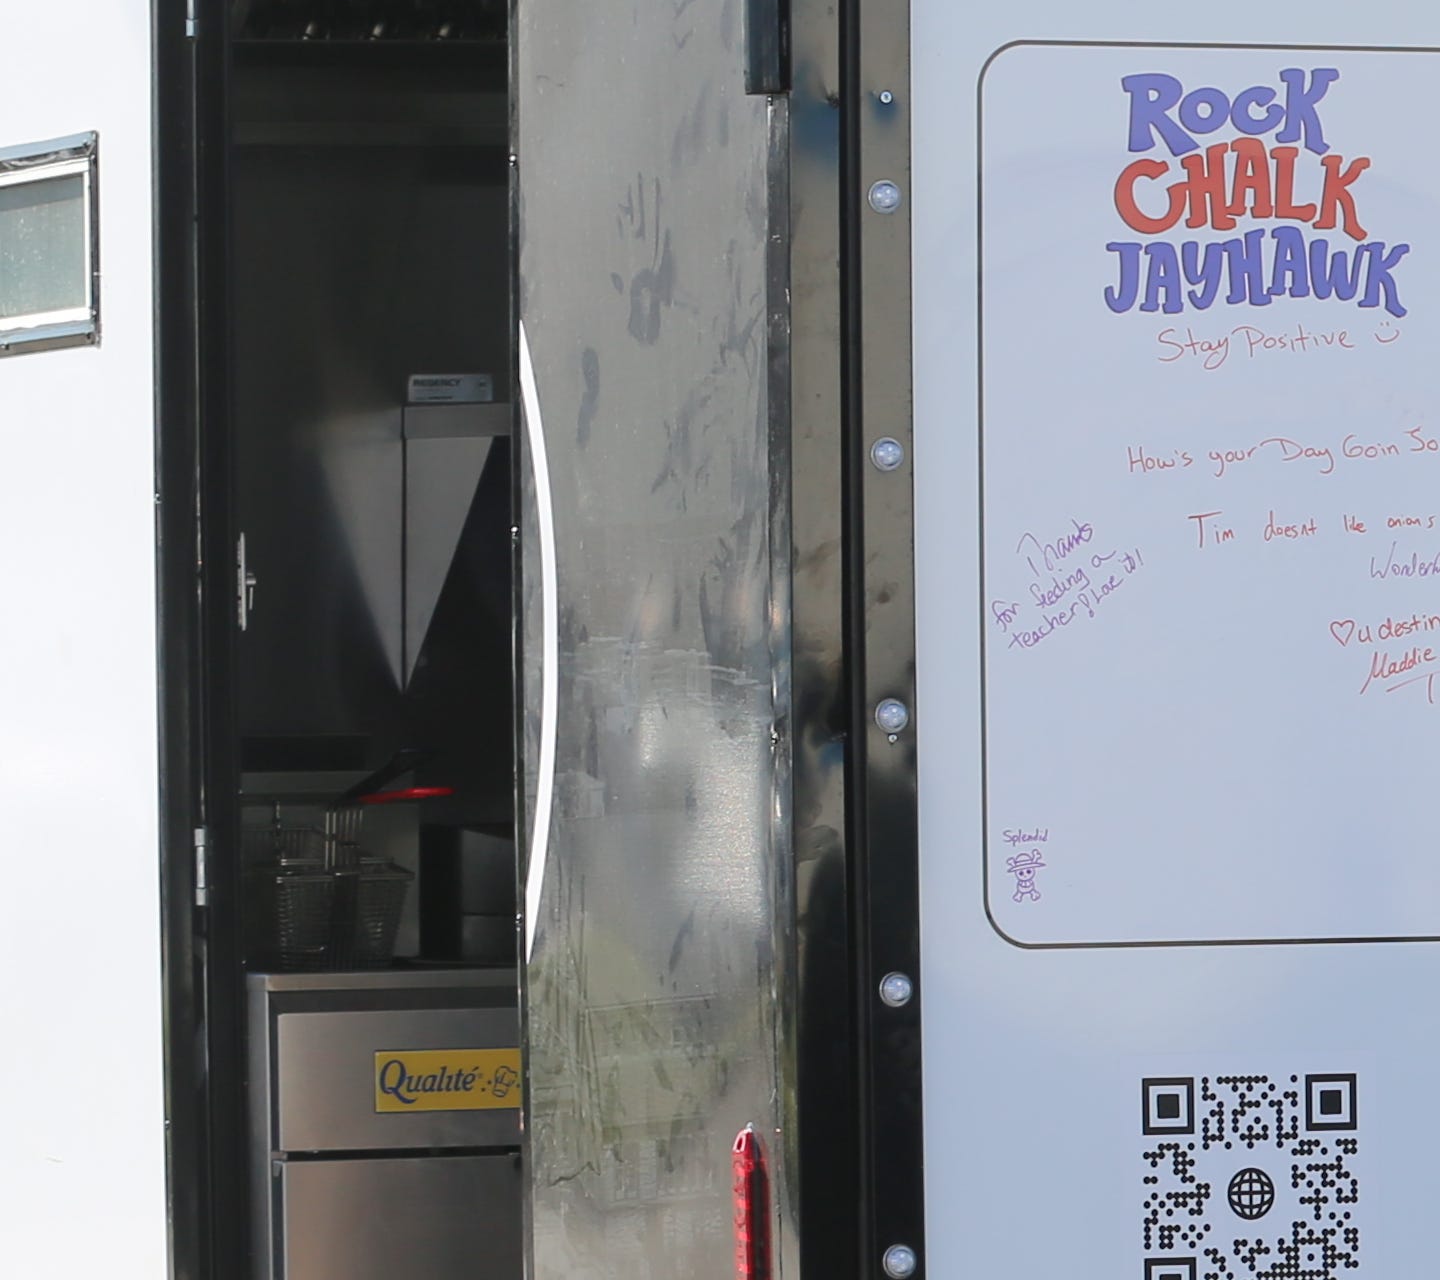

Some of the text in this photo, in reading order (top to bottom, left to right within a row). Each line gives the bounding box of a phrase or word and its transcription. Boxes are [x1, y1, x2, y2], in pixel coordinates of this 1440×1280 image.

[1114, 137, 1370, 241] CHALK
[1104, 226, 1410, 317] JAYHAWK
[1157, 327, 1231, 370] Stay
[1209, 446, 1257, 477] your
[1260, 438, 1334, 474] Day
[1188, 511, 1235, 548] Tim
[992, 600, 1021, 633] for
[1003, 828, 1048, 847] Splendid
